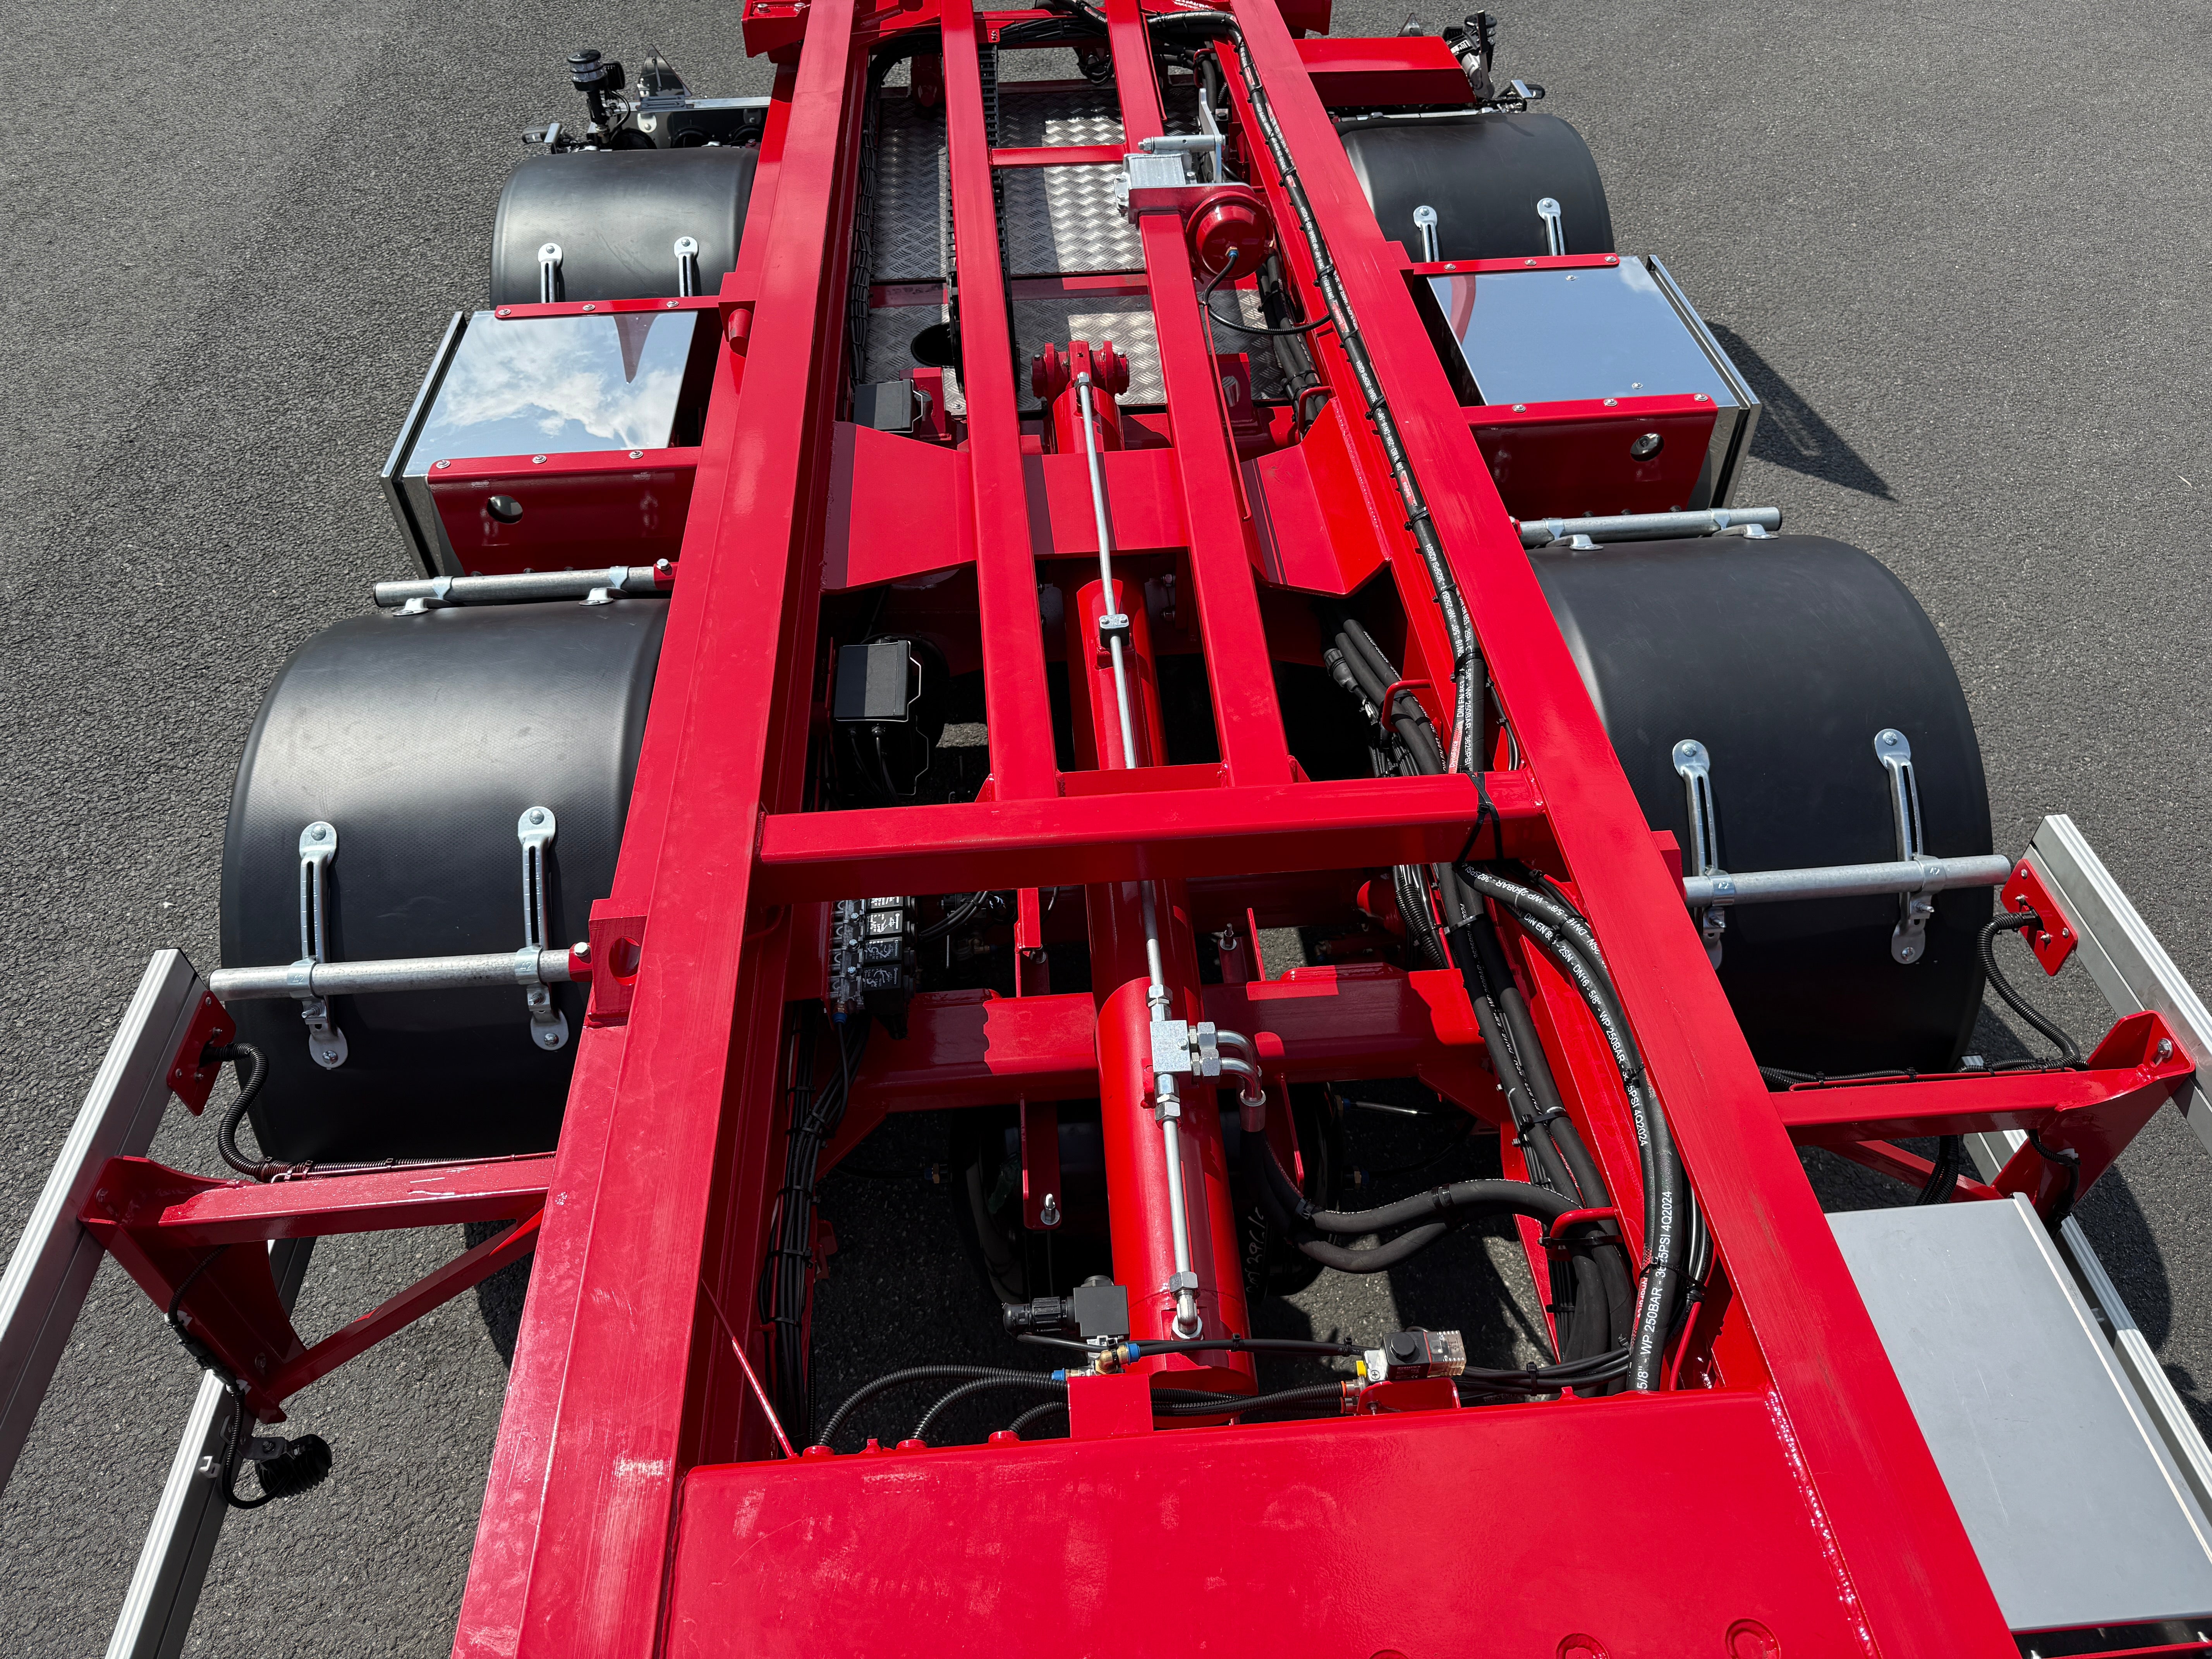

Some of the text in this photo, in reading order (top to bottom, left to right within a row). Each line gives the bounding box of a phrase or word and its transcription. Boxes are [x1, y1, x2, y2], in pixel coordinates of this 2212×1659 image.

[1432, 561, 1445, 583] 3625PSI
[1456, 705, 1464, 717] DIN
[1527, 893, 1544, 903] WP
[1547, 904, 1565, 916] 5/8"
[1566, 917, 1588, 936] DN16
[519, 961, 532, 971] 42
[292, 974, 304, 984] 42
[1524, 913, 1537, 926] DIN
[1535, 922, 1549, 934] EN
[1558, 946, 1574, 962] 2SN
[1573, 963, 1590, 987] DN16
[1588, 989, 1601, 1004] 5/8"
[1599, 1010, 1611, 1027] WP
[1606, 1027, 1626, 1064] 250BAR
[1633, 1109, 1649, 1147] 4Q2024
[1661, 1191, 1673, 1232] 4Q2024
[1644, 1287, 1663, 1333] 250BAR
[1640, 1334, 1653, 1355] WP
[1637, 1365, 1649, 1390] 5/8"
